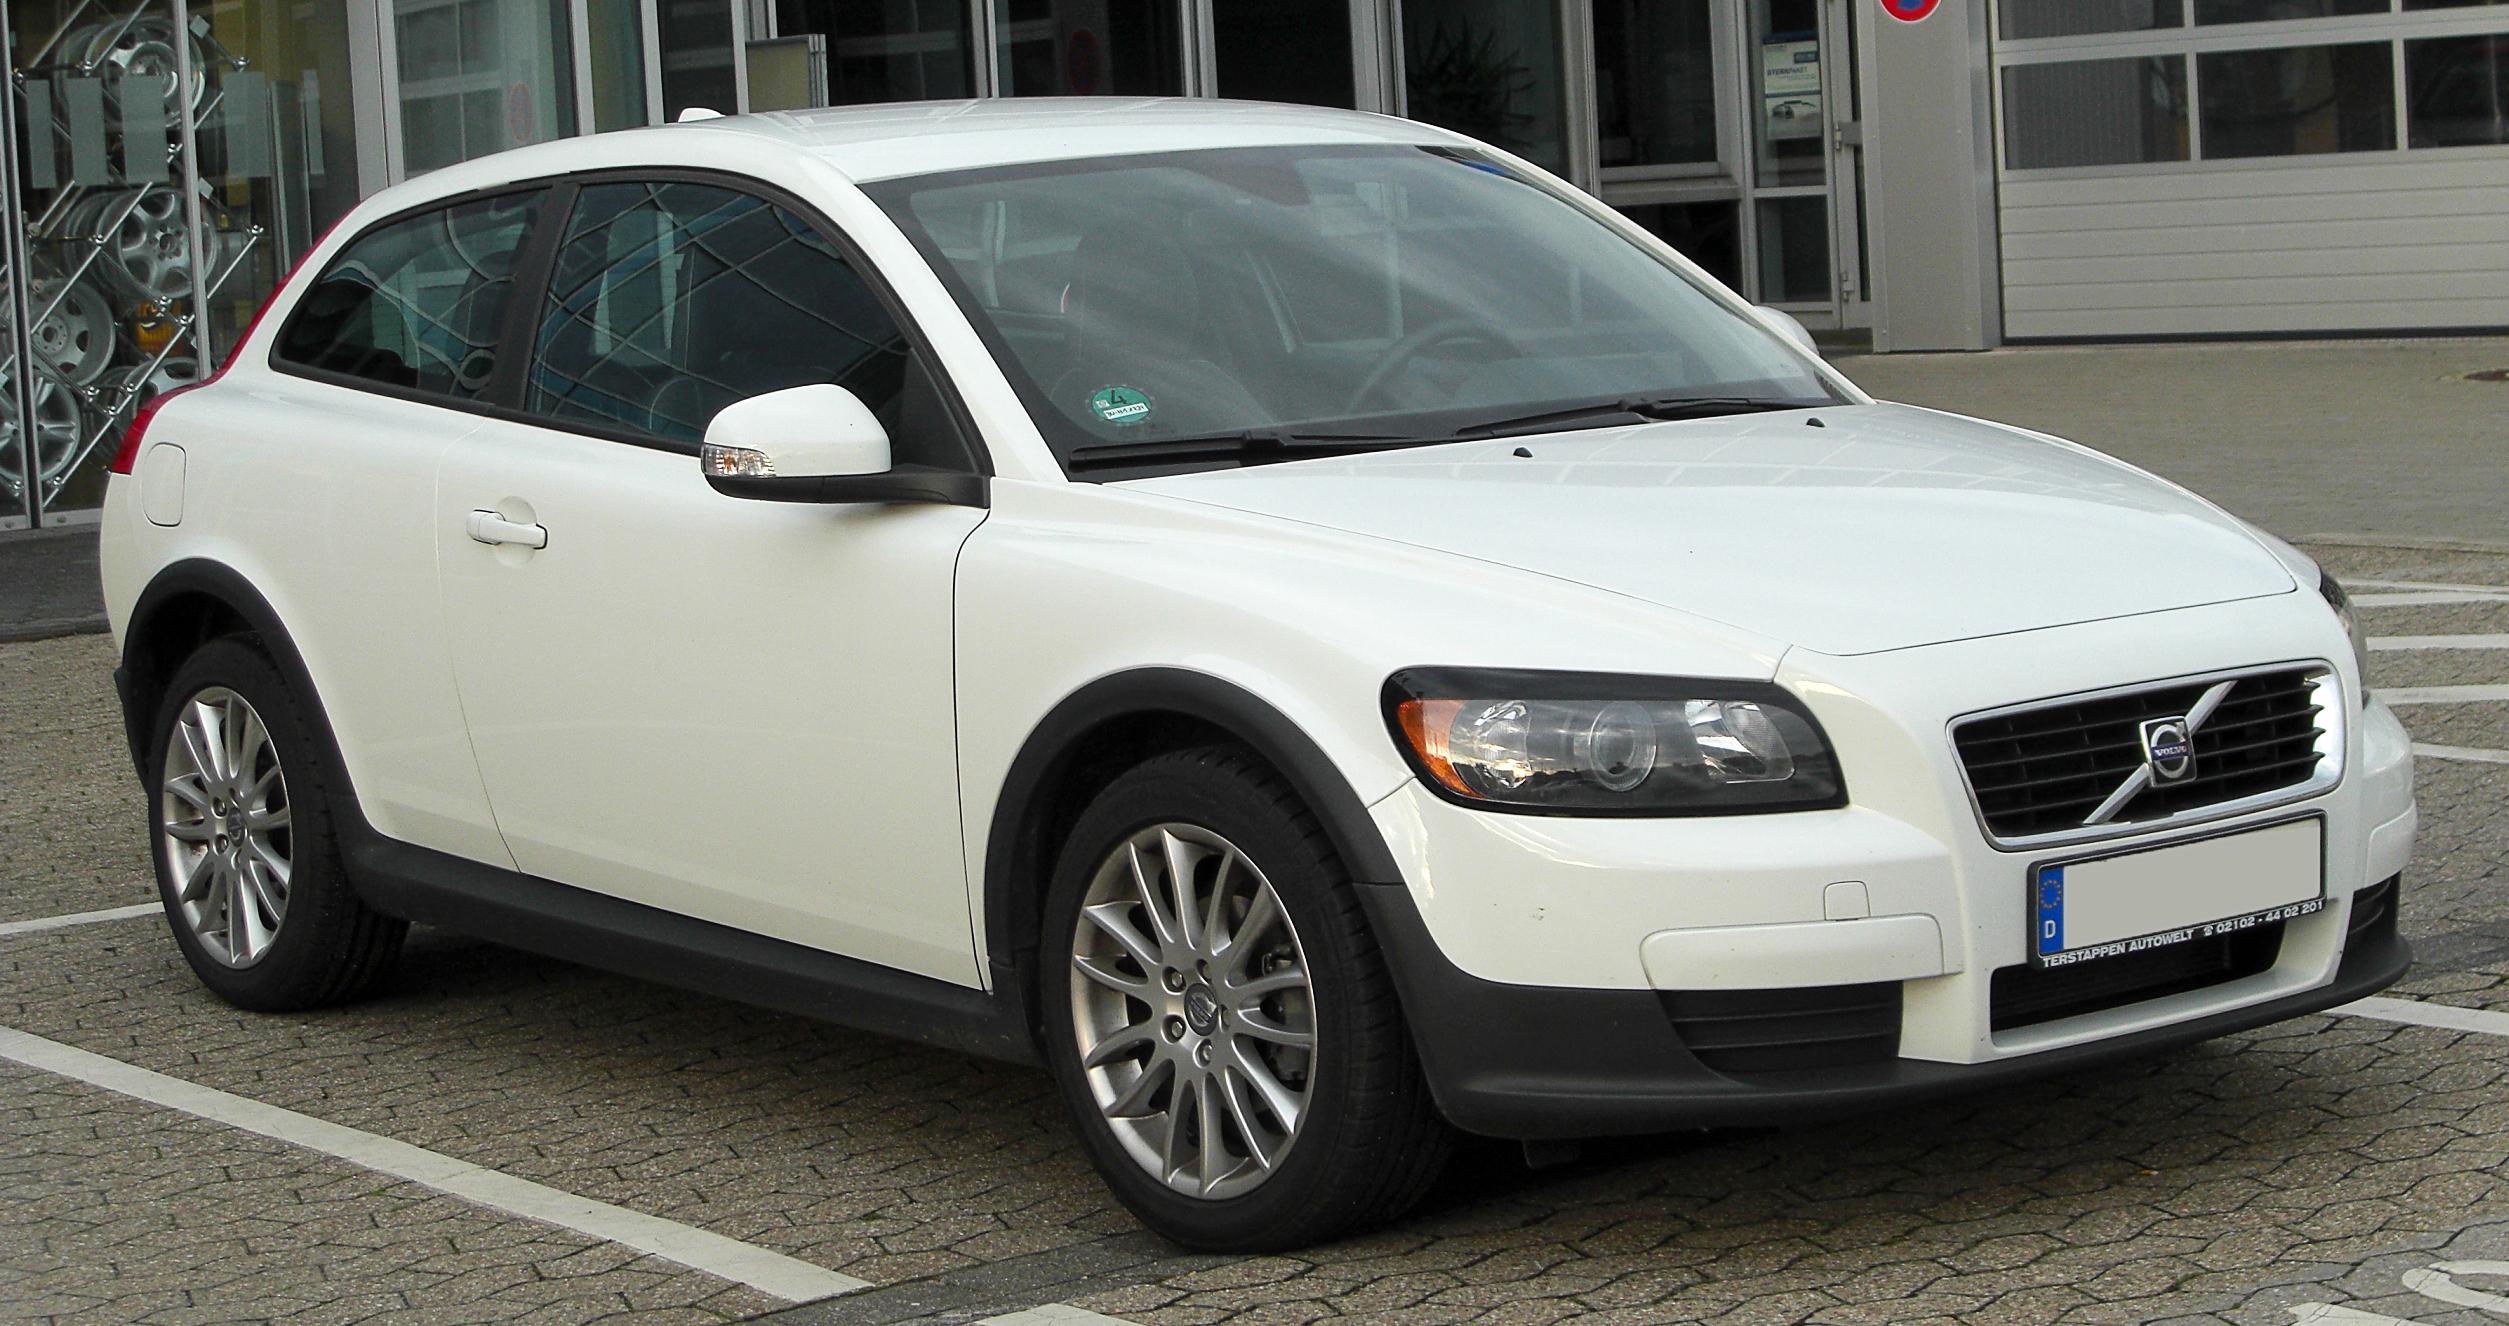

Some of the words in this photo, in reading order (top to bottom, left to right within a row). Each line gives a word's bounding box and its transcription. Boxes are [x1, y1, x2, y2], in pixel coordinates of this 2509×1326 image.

[1110, 389, 1127, 405] 4
[2154, 745, 2187, 757] VOLVO
[2043, 942, 2125, 968] TERSTAPPEN
[2128, 929, 2194, 952] AUTOWELT
[2216, 916, 2256, 935] 02102
[2265, 909, 2281, 923] 44
[2283, 905, 2300, 919] 02
[2301, 900, 2323, 915] 201
[2044, 920, 2057, 939] D
